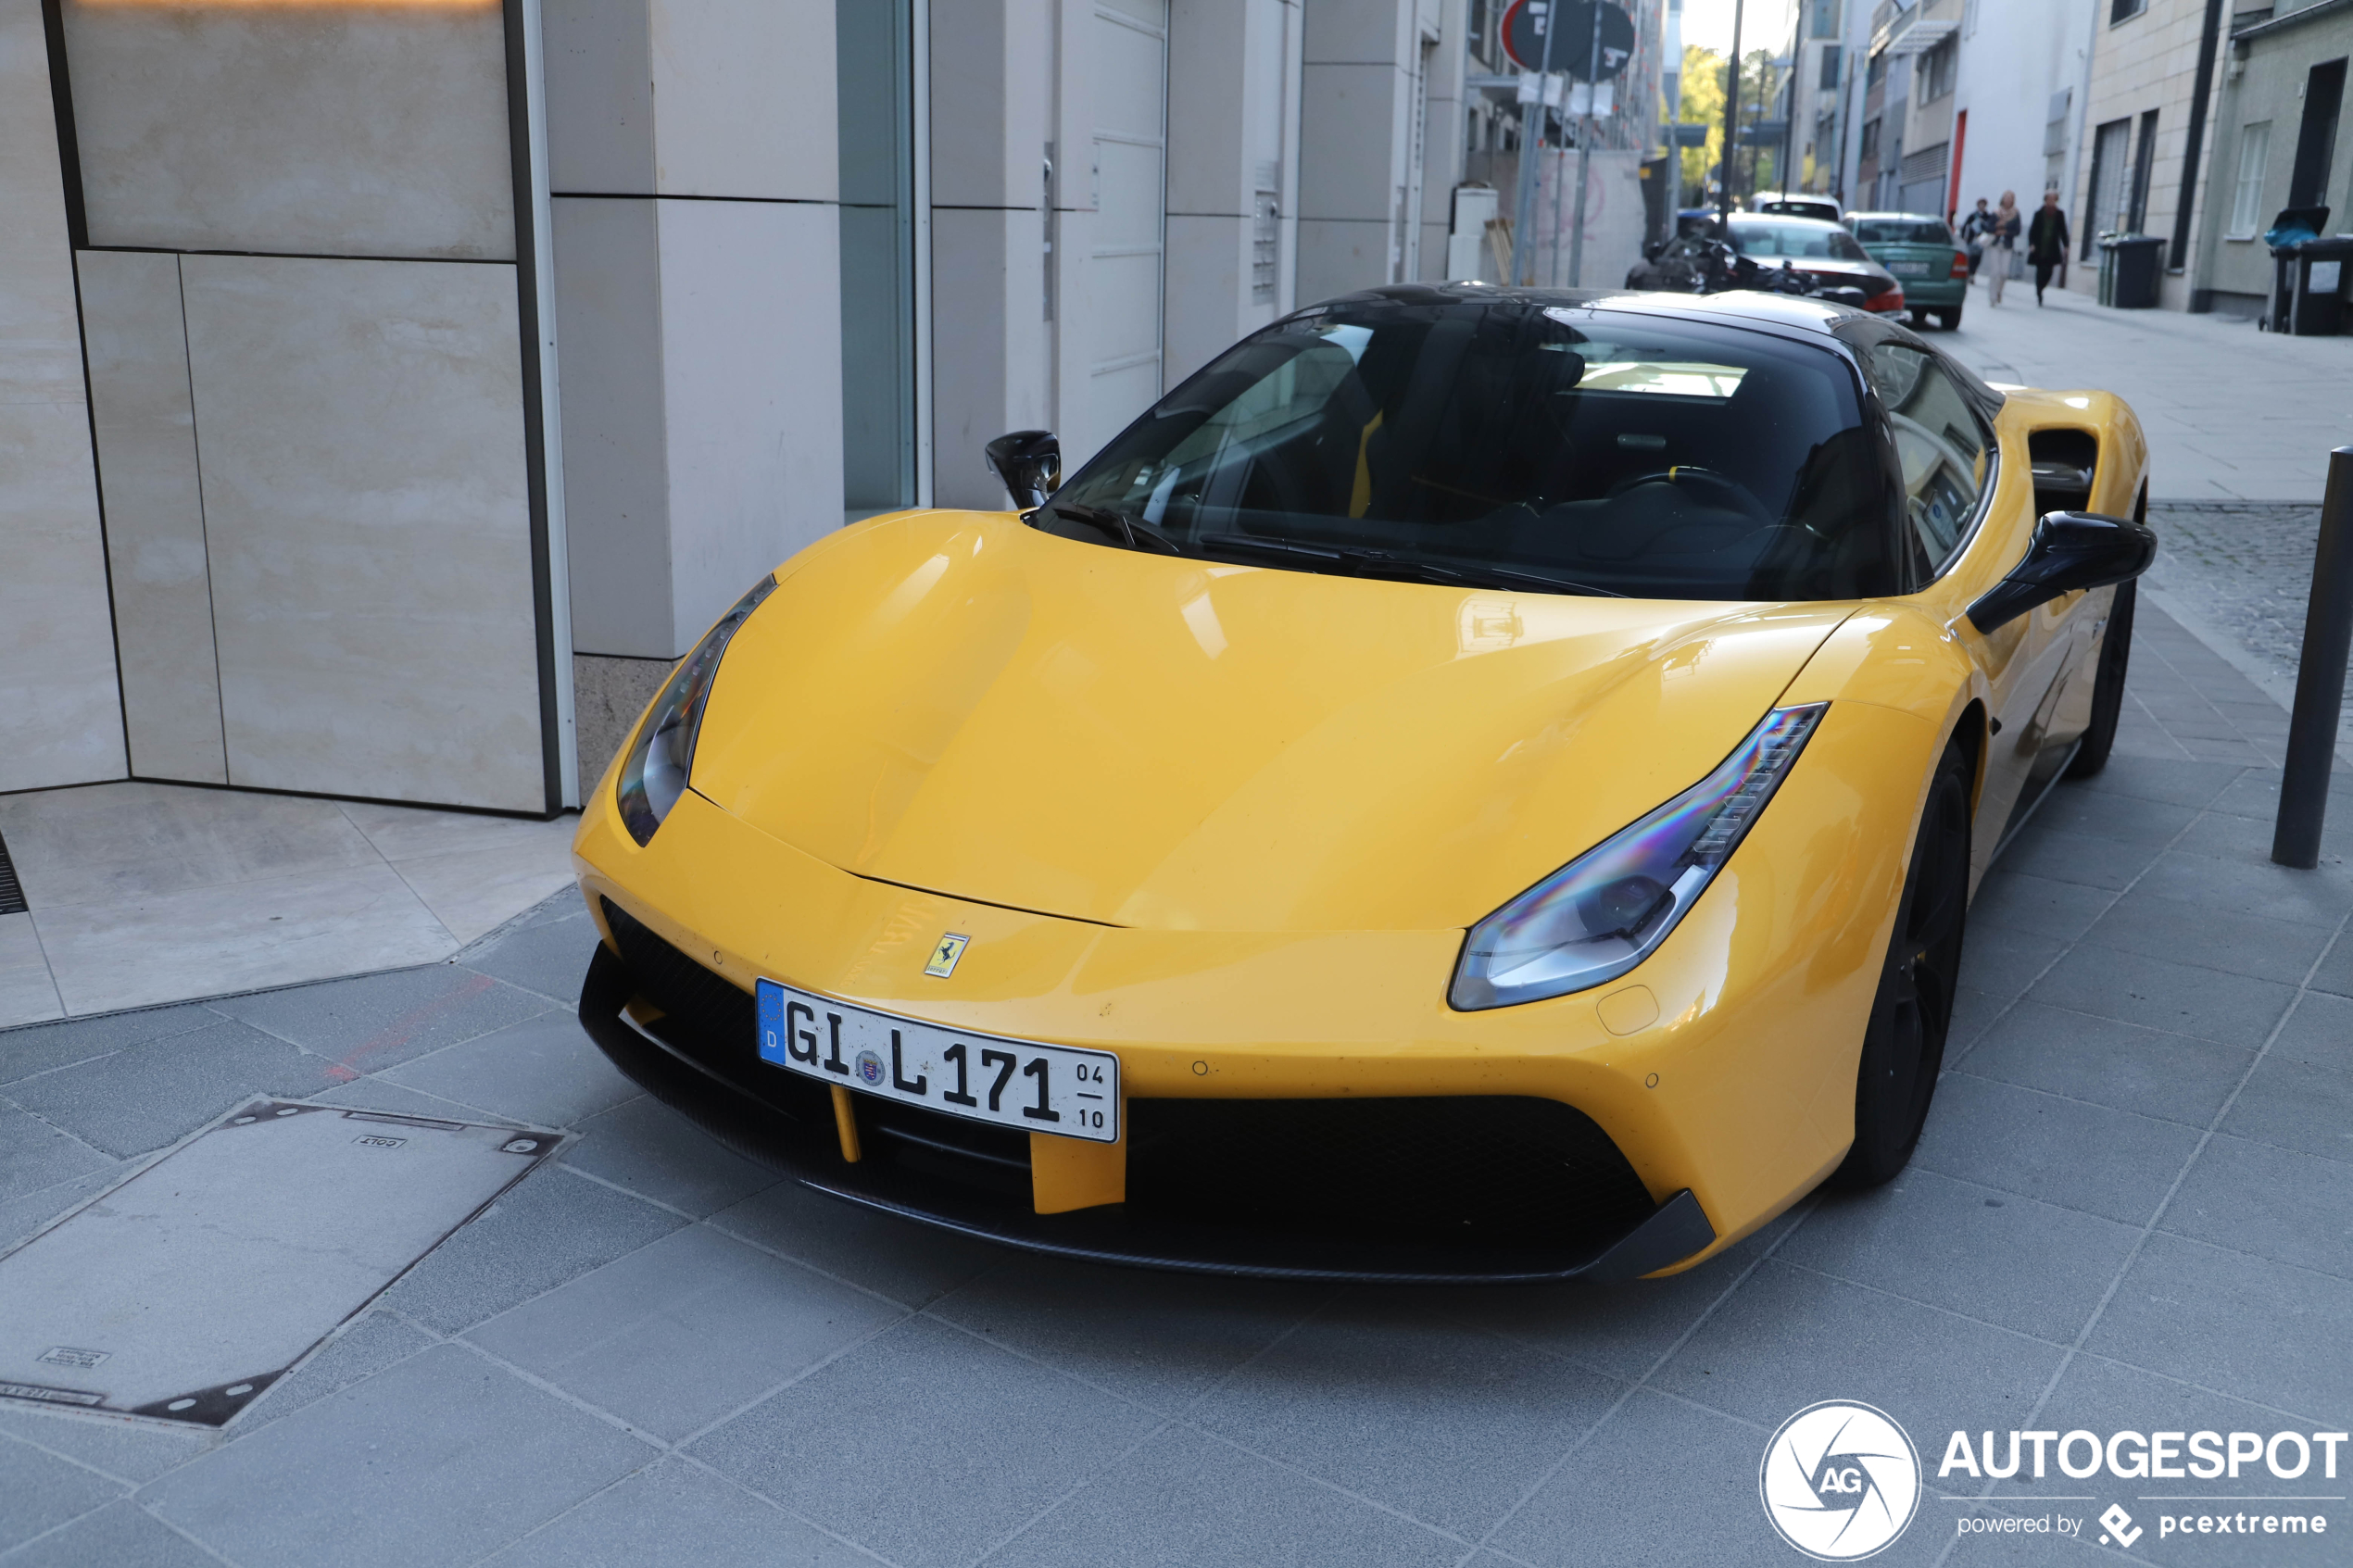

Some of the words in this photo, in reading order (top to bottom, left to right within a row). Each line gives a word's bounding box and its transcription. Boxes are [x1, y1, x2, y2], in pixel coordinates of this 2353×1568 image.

[767, 1030, 777, 1047] D
[786, 1000, 849, 1075] GI
[891, 1028, 927, 1096] L
[943, 1043, 1060, 1122] 171
[1076, 1063, 1103, 1084] 04
[1079, 1109, 1103, 1128] 10
[359, 1138, 396, 1147] COLT
